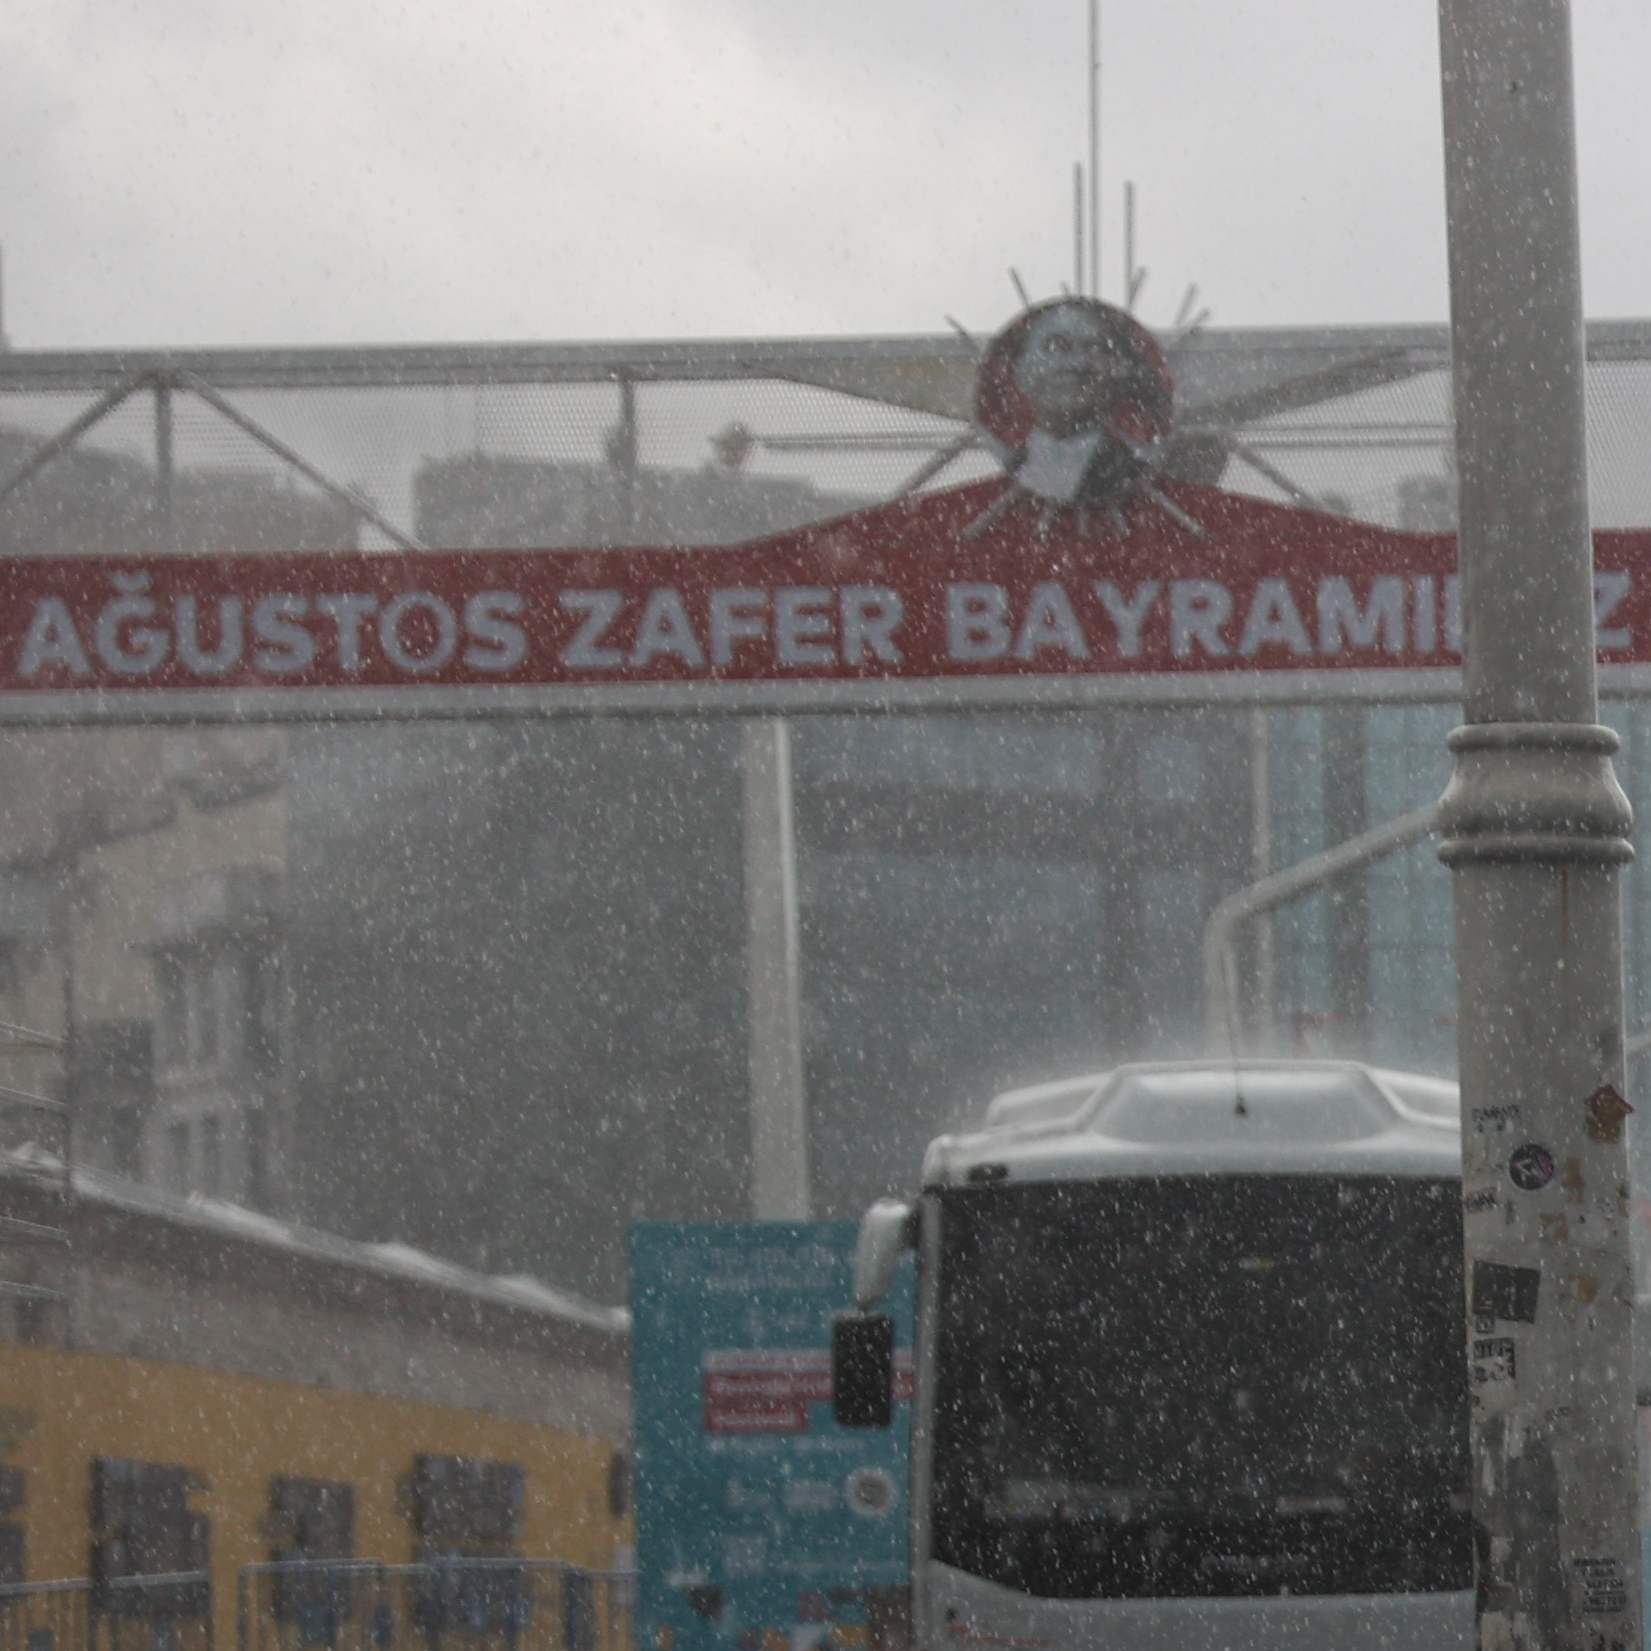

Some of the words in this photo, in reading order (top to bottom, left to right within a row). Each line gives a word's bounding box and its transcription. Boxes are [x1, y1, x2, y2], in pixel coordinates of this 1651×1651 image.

[15, 573, 531, 677] AĞUSTOS
[561, 583, 905, 670] ZAFER
[945, 572, 1632, 661] BAYRAMIZ
